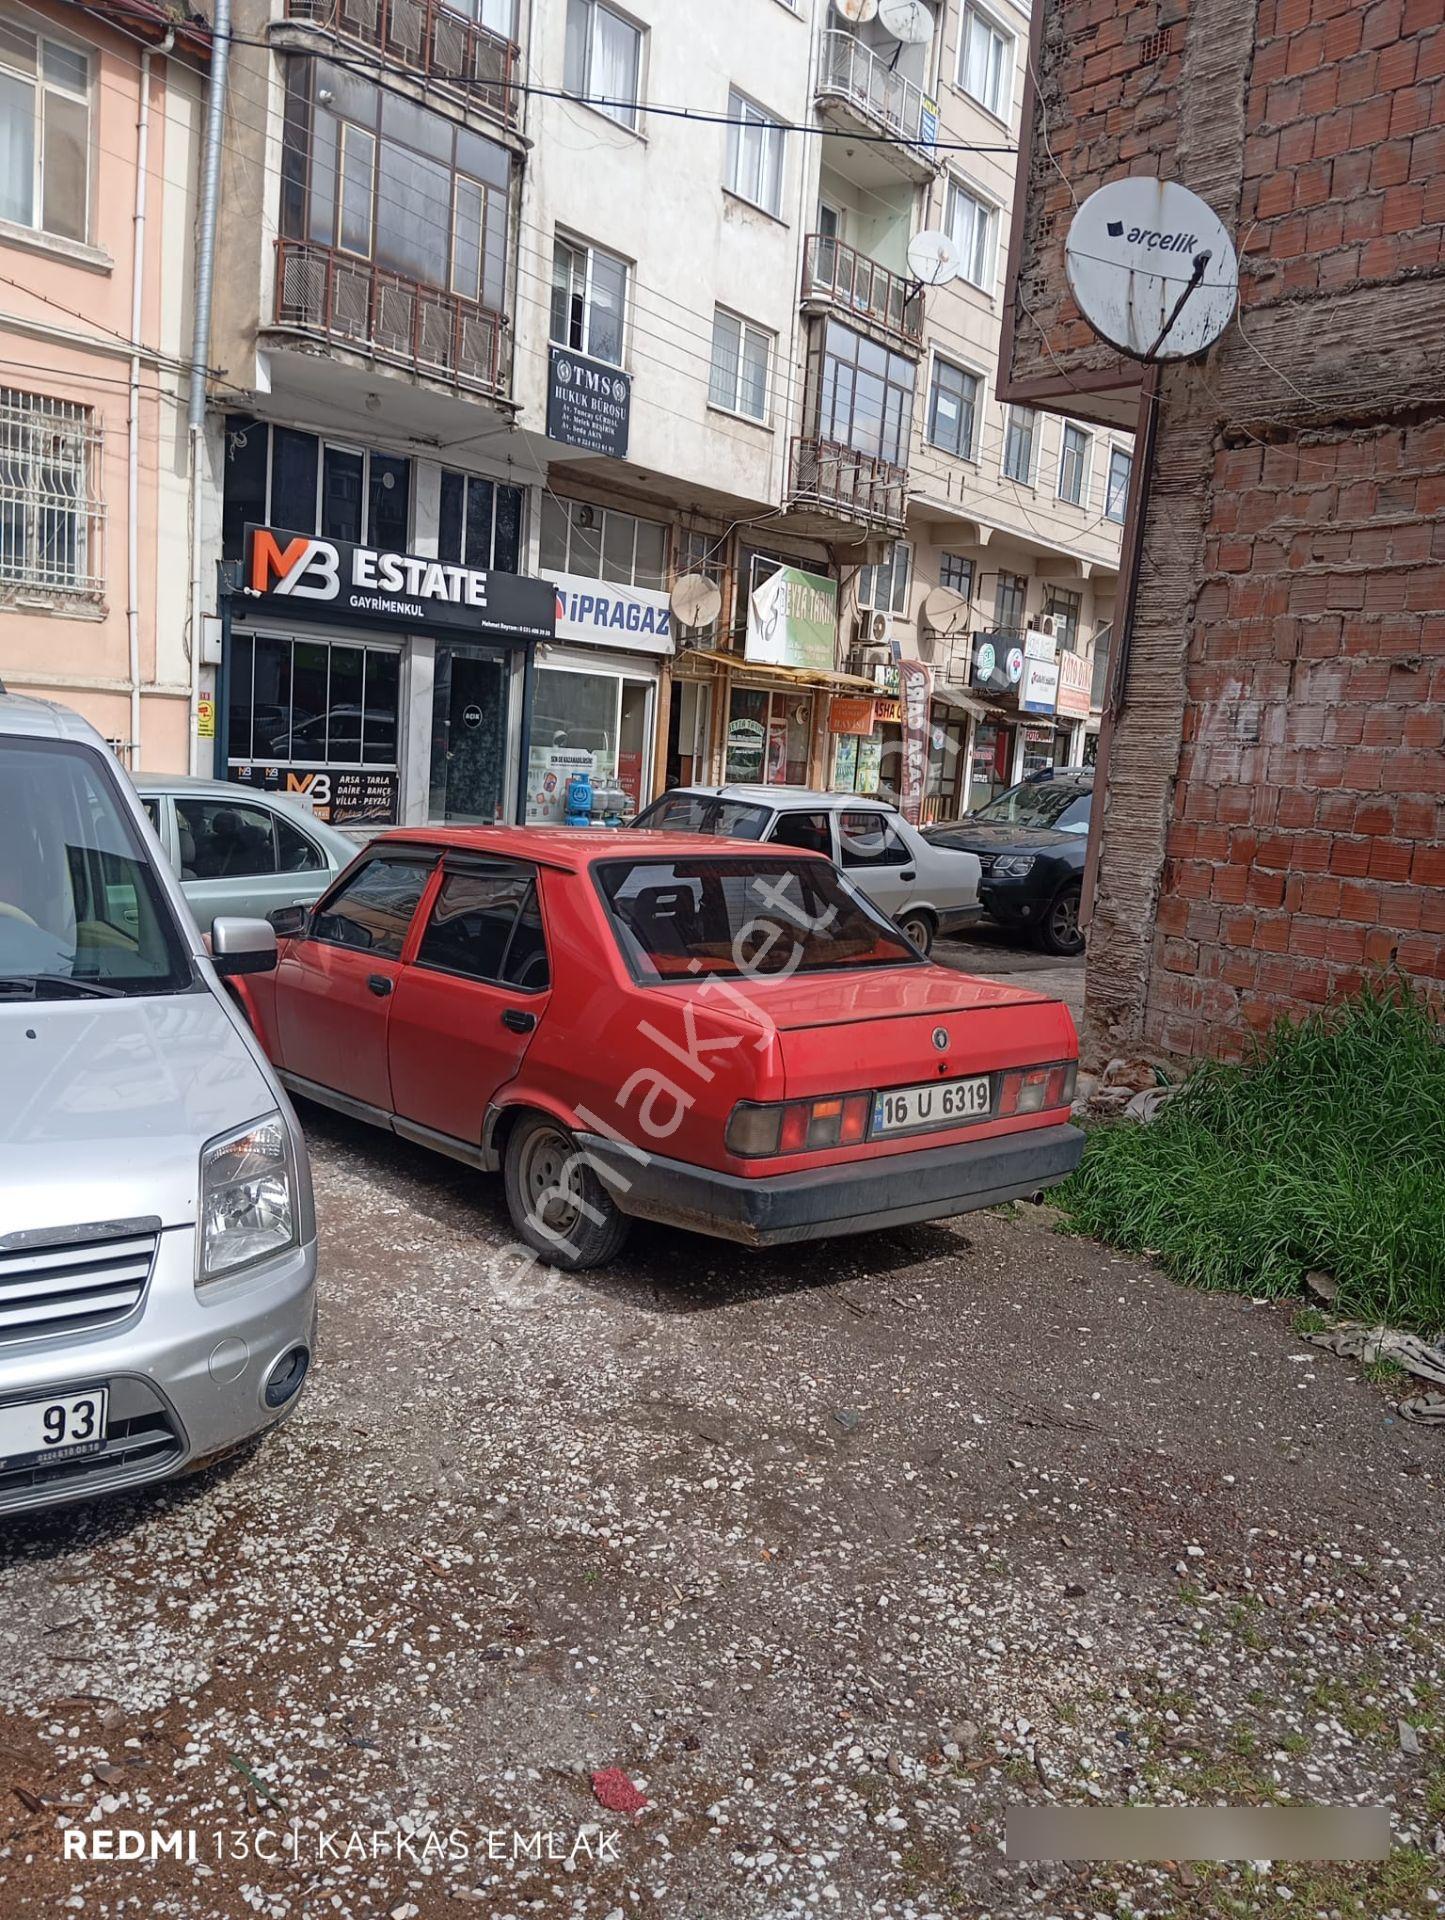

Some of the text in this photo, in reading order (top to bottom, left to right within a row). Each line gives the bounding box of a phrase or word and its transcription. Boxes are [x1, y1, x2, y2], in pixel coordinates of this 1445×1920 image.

[1127, 227, 1198, 254] arçelik
[573, 365, 611, 395] TMS
[555, 385, 626, 420] HUKUK BÜROSU
[252, 529, 341, 600] MB
[352, 548, 488, 607] ESTATE
[349, 595, 424, 617] GAYRİMENKUL
[337, 785, 361, 794] DAİRE
[367, 787, 391, 796] BAHÇE
[339, 776, 360, 784] ARSA
[367, 776, 390, 784] TARLA
[335, 796, 357, 805] VİLLA
[363, 798, 390, 807] PEYZAJ
[885, 1083, 988, 1124] 16 U 6319
[43, 1400, 95, 1445] 93
